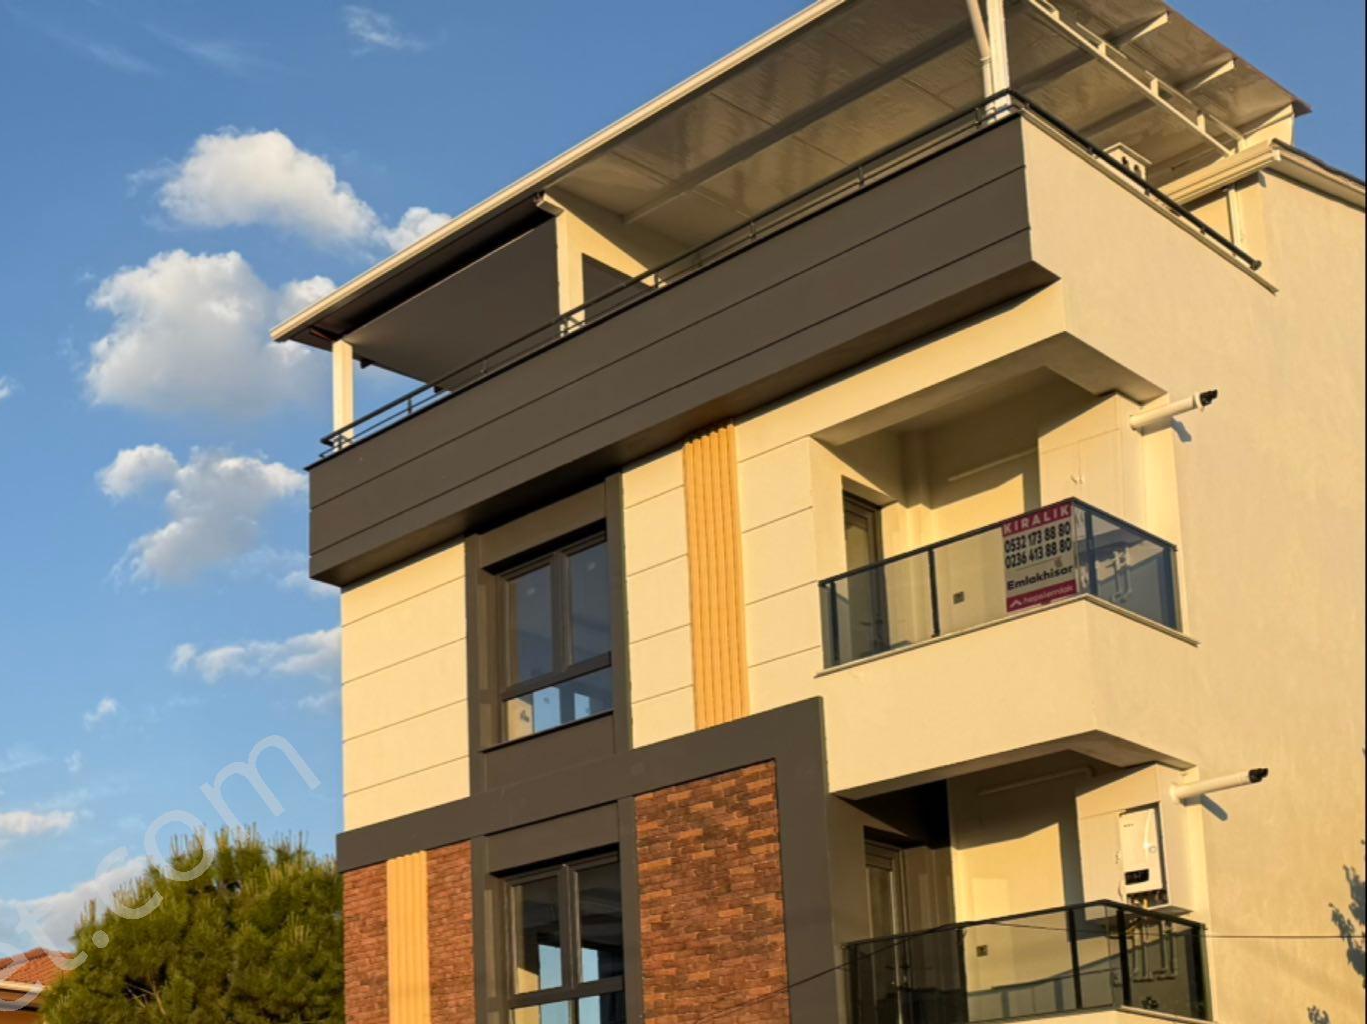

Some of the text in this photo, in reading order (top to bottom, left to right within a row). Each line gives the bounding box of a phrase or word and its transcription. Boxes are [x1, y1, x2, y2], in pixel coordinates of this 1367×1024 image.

[1004, 521, 1071, 553] 0532 173 88 80
[1005, 537, 1072, 569] 0236 413 88 80
